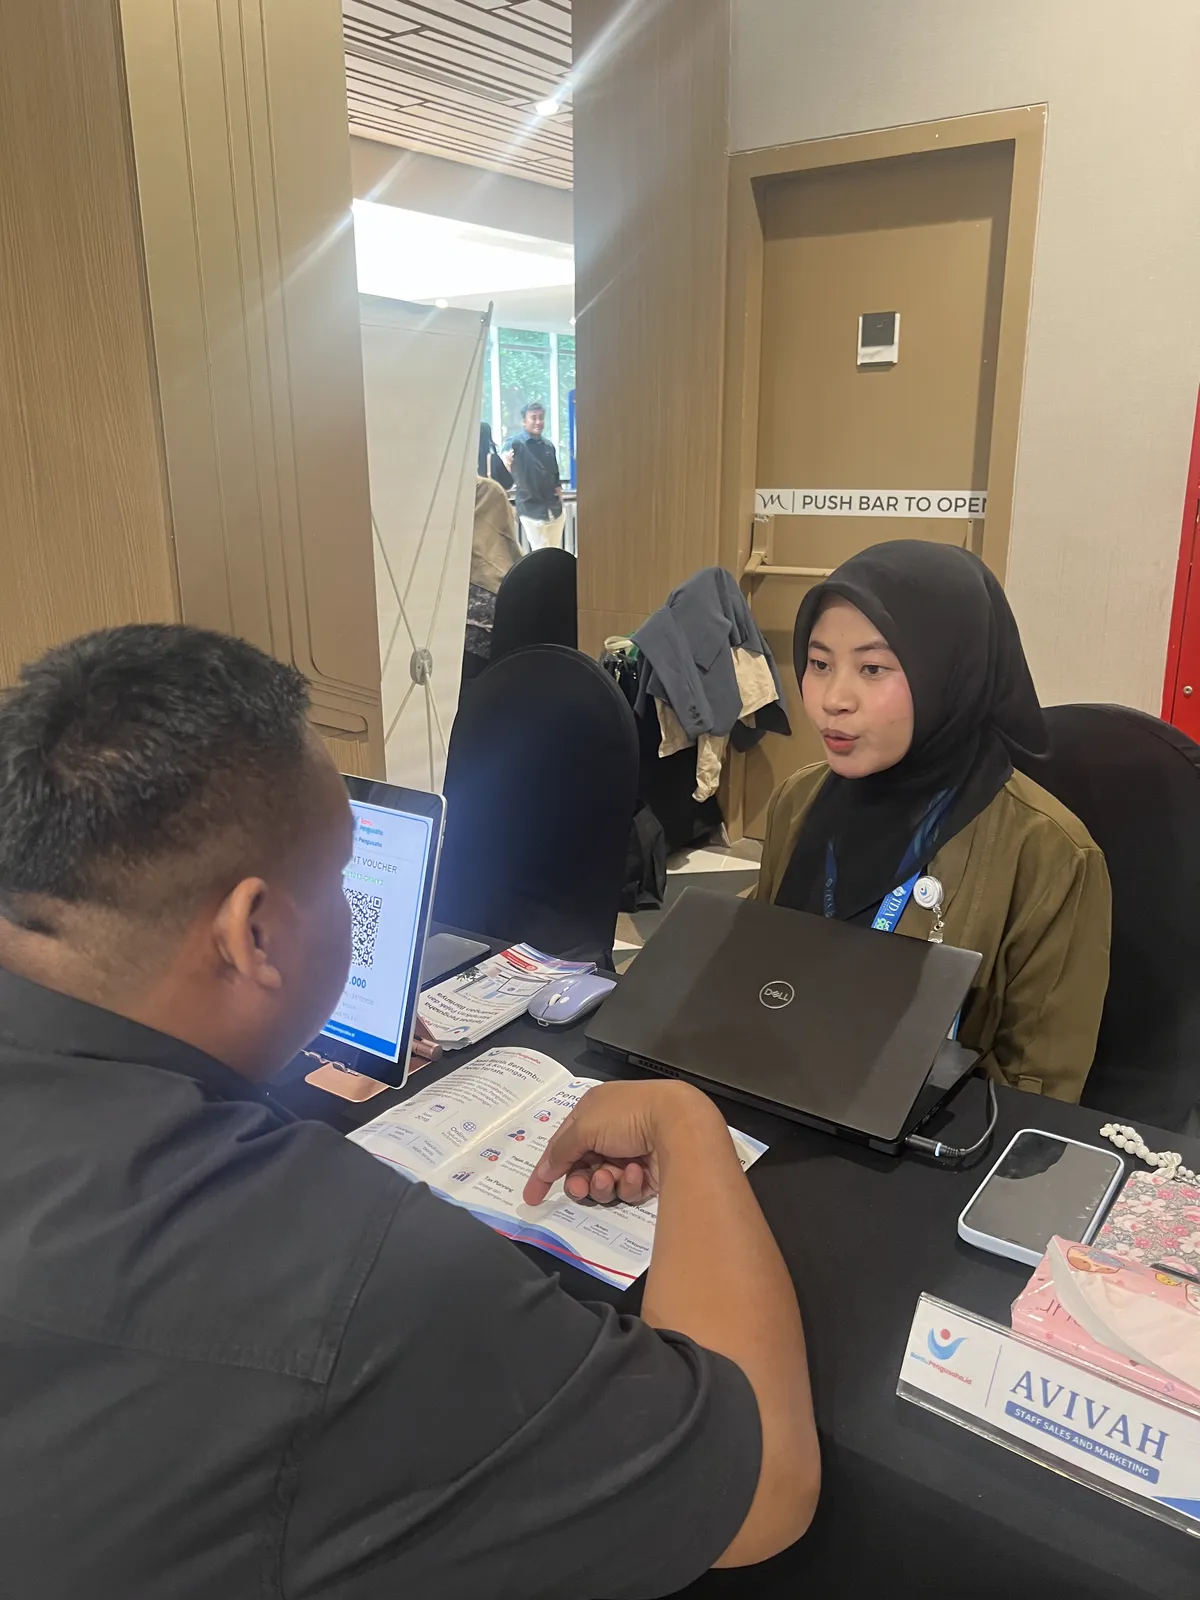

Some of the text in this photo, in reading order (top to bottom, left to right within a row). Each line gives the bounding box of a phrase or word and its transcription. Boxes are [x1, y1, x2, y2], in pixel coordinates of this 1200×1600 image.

[802, 494, 852, 511] PUSH
[858, 495, 898, 512] BAR
[904, 496, 931, 512] TO
[362, 857, 398, 874] VOUCHER
[764, 988, 789, 1002] DELL
[491, 1063, 527, 1081] Keuangan
[548, 1096, 576, 1109] Pajak
[484, 1175, 515, 1193] Tax Planning
[910, 1351, 973, 1386] BantuPengusaha.id
[1009, 1370, 1170, 1462] AVIVAH
[1014, 1407, 1150, 1478] STAFF SALES AND MARKETING
